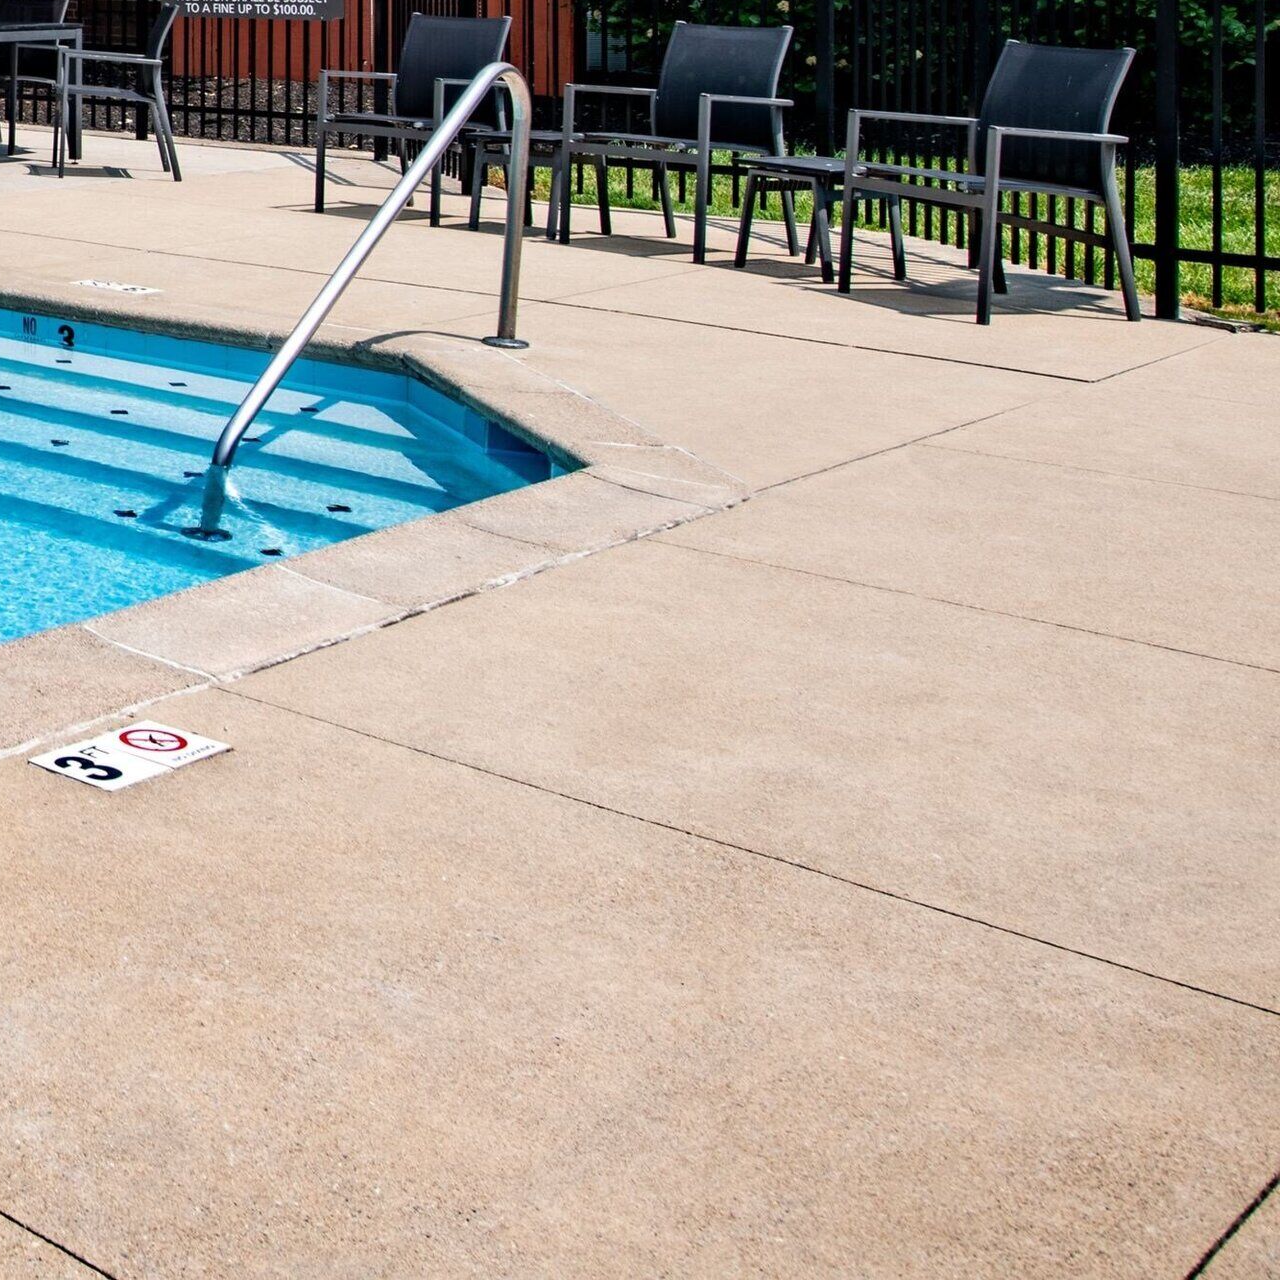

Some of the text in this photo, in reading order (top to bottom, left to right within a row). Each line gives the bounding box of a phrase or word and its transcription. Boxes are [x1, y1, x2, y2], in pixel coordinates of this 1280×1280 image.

[185, 3, 316, 16] TO A FINE UP TO $100.00.
[54, 745, 123, 781] 3 FT
